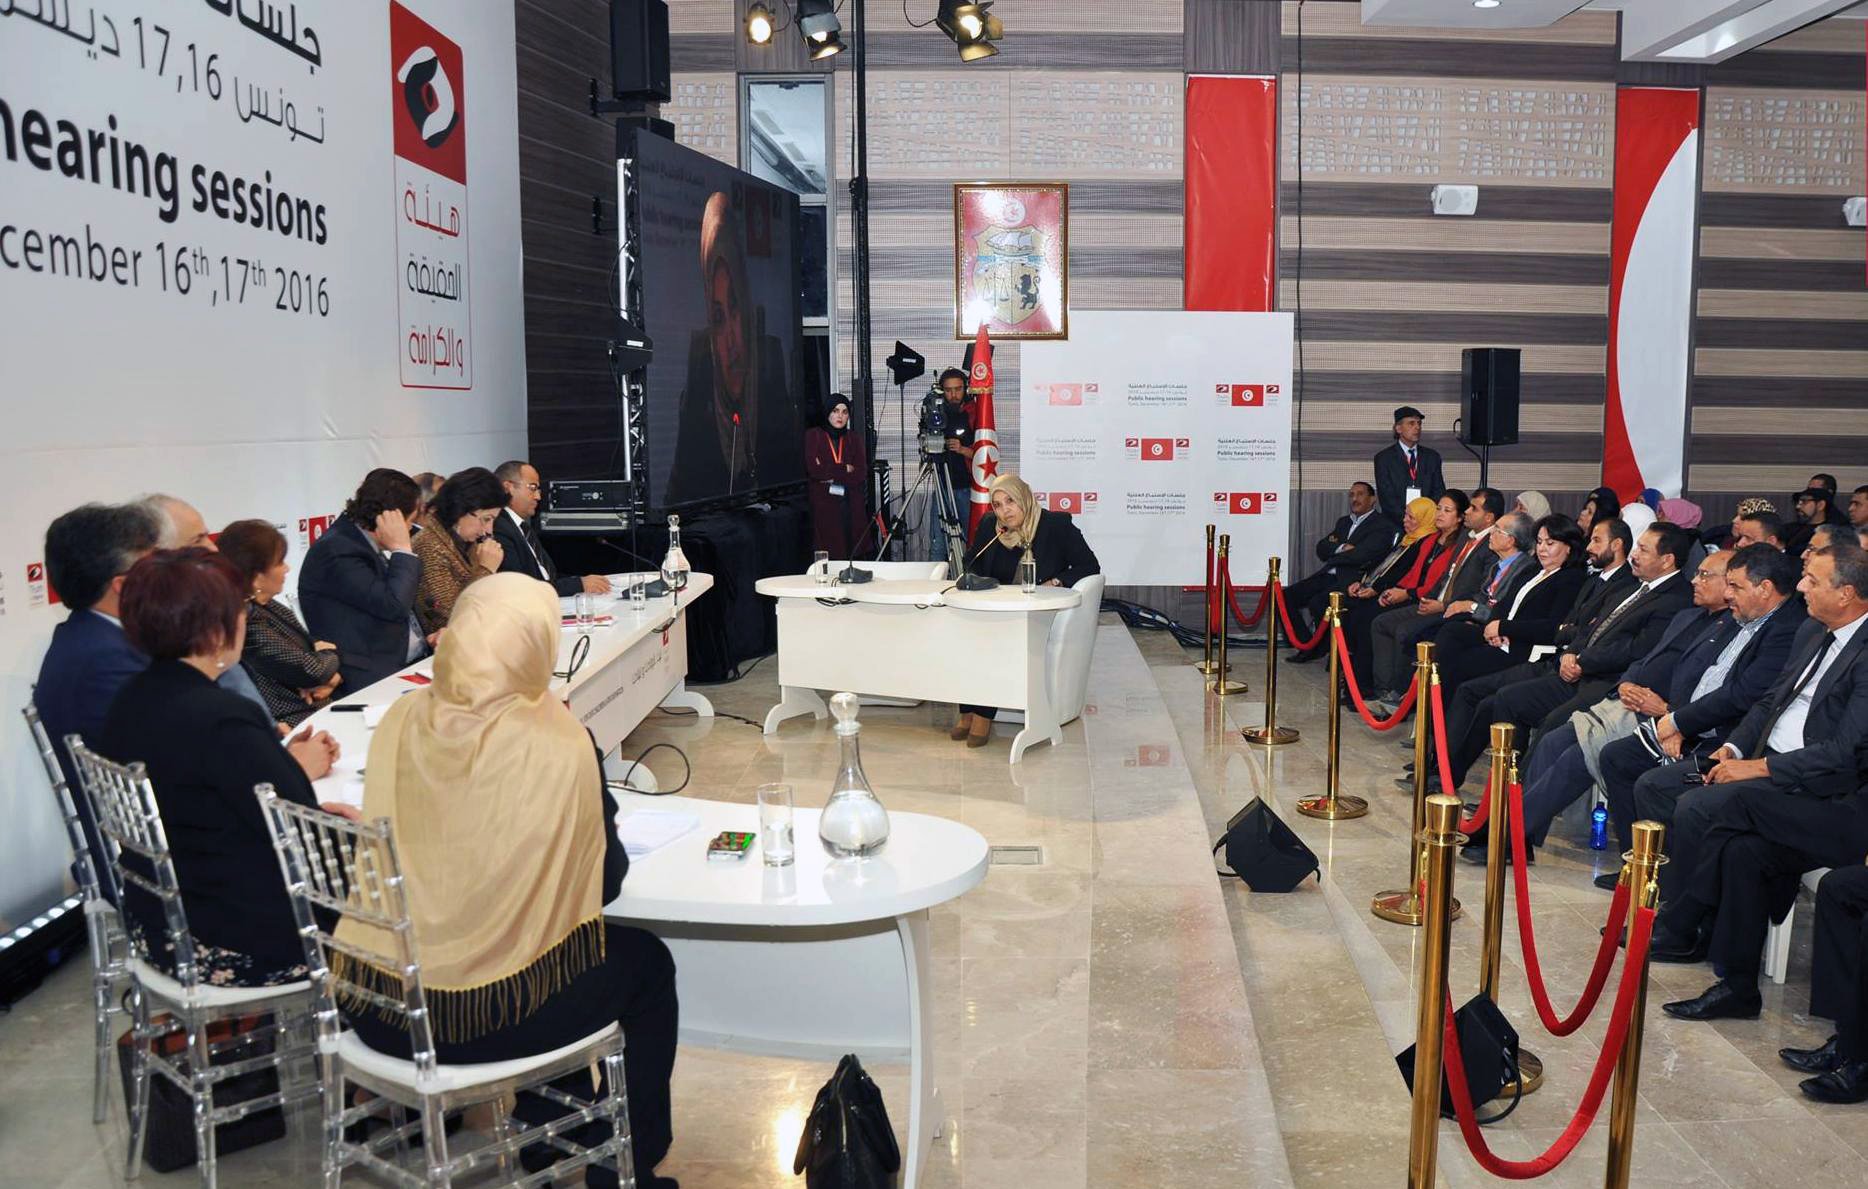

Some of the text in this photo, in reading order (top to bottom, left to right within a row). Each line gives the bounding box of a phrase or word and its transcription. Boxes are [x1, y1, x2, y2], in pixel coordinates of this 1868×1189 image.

[234, 77, 324, 144] تونس
[191, 163, 328, 245] sessions
[404, 182, 461, 238] هيئة
[275, 267, 330, 317] 2016
[406, 252, 462, 304] الحقيقة
[408, 324, 464, 377] والكرامة
